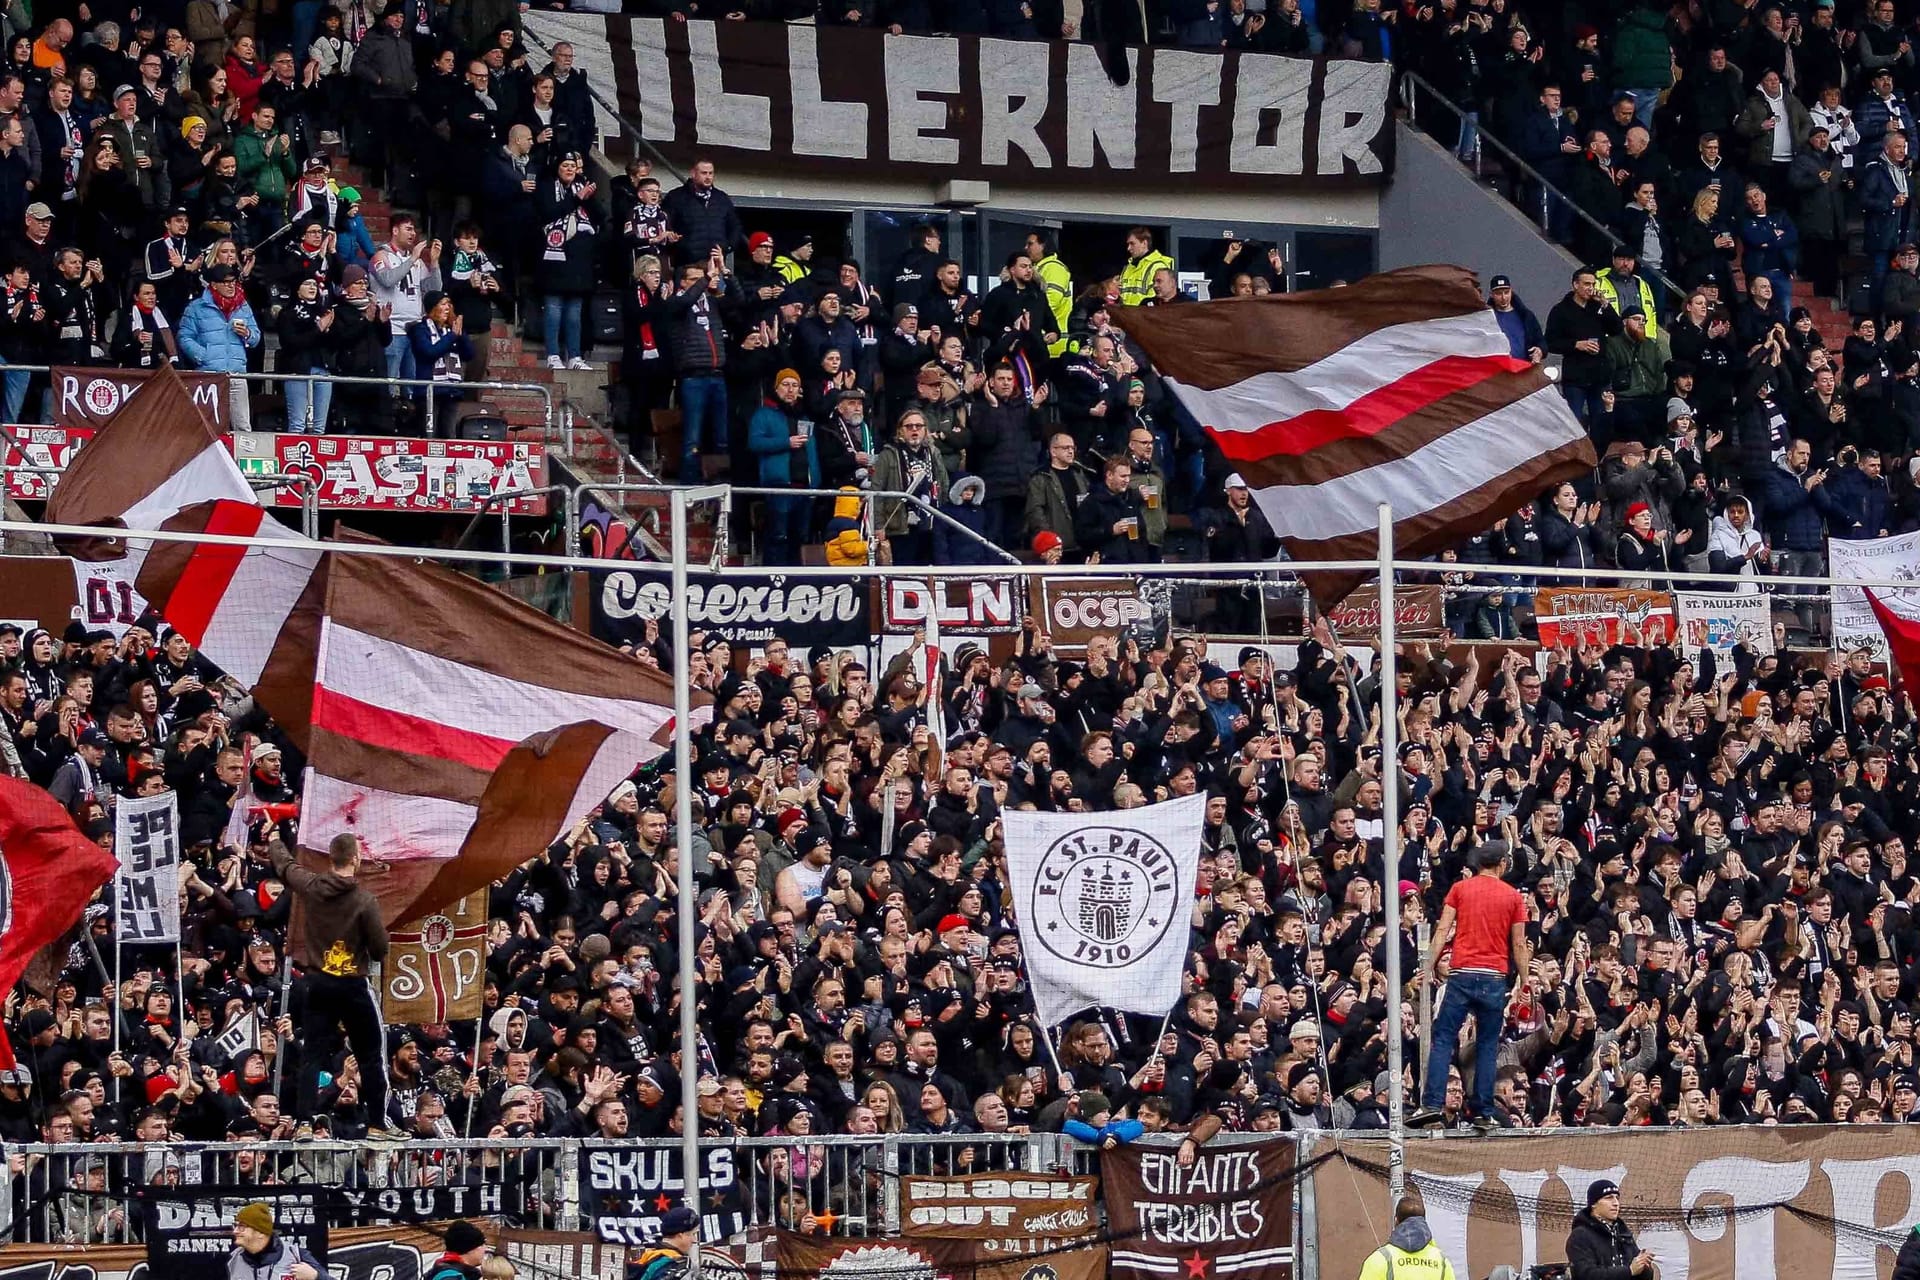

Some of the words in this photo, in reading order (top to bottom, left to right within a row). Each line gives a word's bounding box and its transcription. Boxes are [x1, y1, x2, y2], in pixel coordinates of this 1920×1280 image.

[332, 452, 535, 498] ASTRA
[890, 580, 1012, 624] DLN
[1054, 597, 1140, 628] OCSP
[1550, 592, 1614, 616] FLYING
[1685, 600, 1700, 609] ST.
[736, 627, 776, 641] Pauli
[1040, 866, 1064, 896] FC
[1062, 836, 1098, 861] ST.
[1109, 833, 1171, 893] PAULI
[1074, 939, 1131, 964] 1910
[1140, 1150, 1260, 1194] ENFANTS
[342, 1184, 502, 1216] YOUTH
[909, 1206, 1016, 1226] OUT
[1133, 1199, 1264, 1244] TERRIBLES
[167, 1238, 232, 1253] SANKT
[1397, 1257, 1439, 1270] ORDNER
